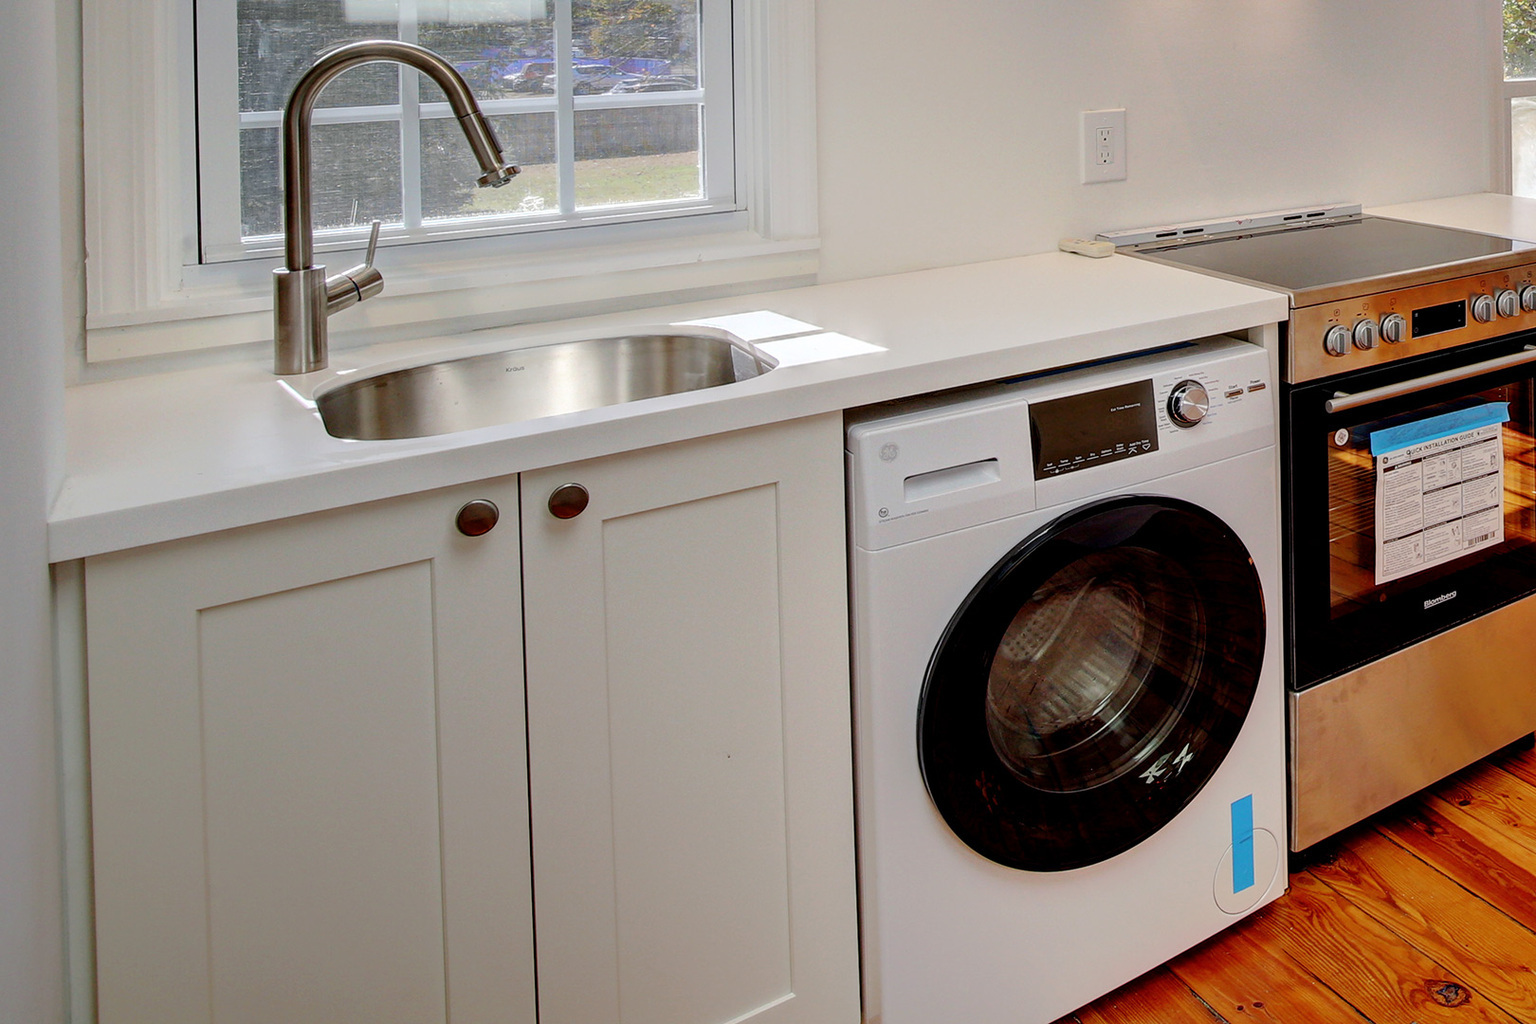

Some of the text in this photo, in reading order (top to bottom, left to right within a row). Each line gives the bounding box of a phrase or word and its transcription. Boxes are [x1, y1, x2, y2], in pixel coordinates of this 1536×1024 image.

[1406, 446, 1422, 457] QUICK
[1423, 436, 1459, 450] INSTALLATION
[1458, 432, 1475, 441] GUIDE
[1423, 590, 1457, 610] Blomberg
